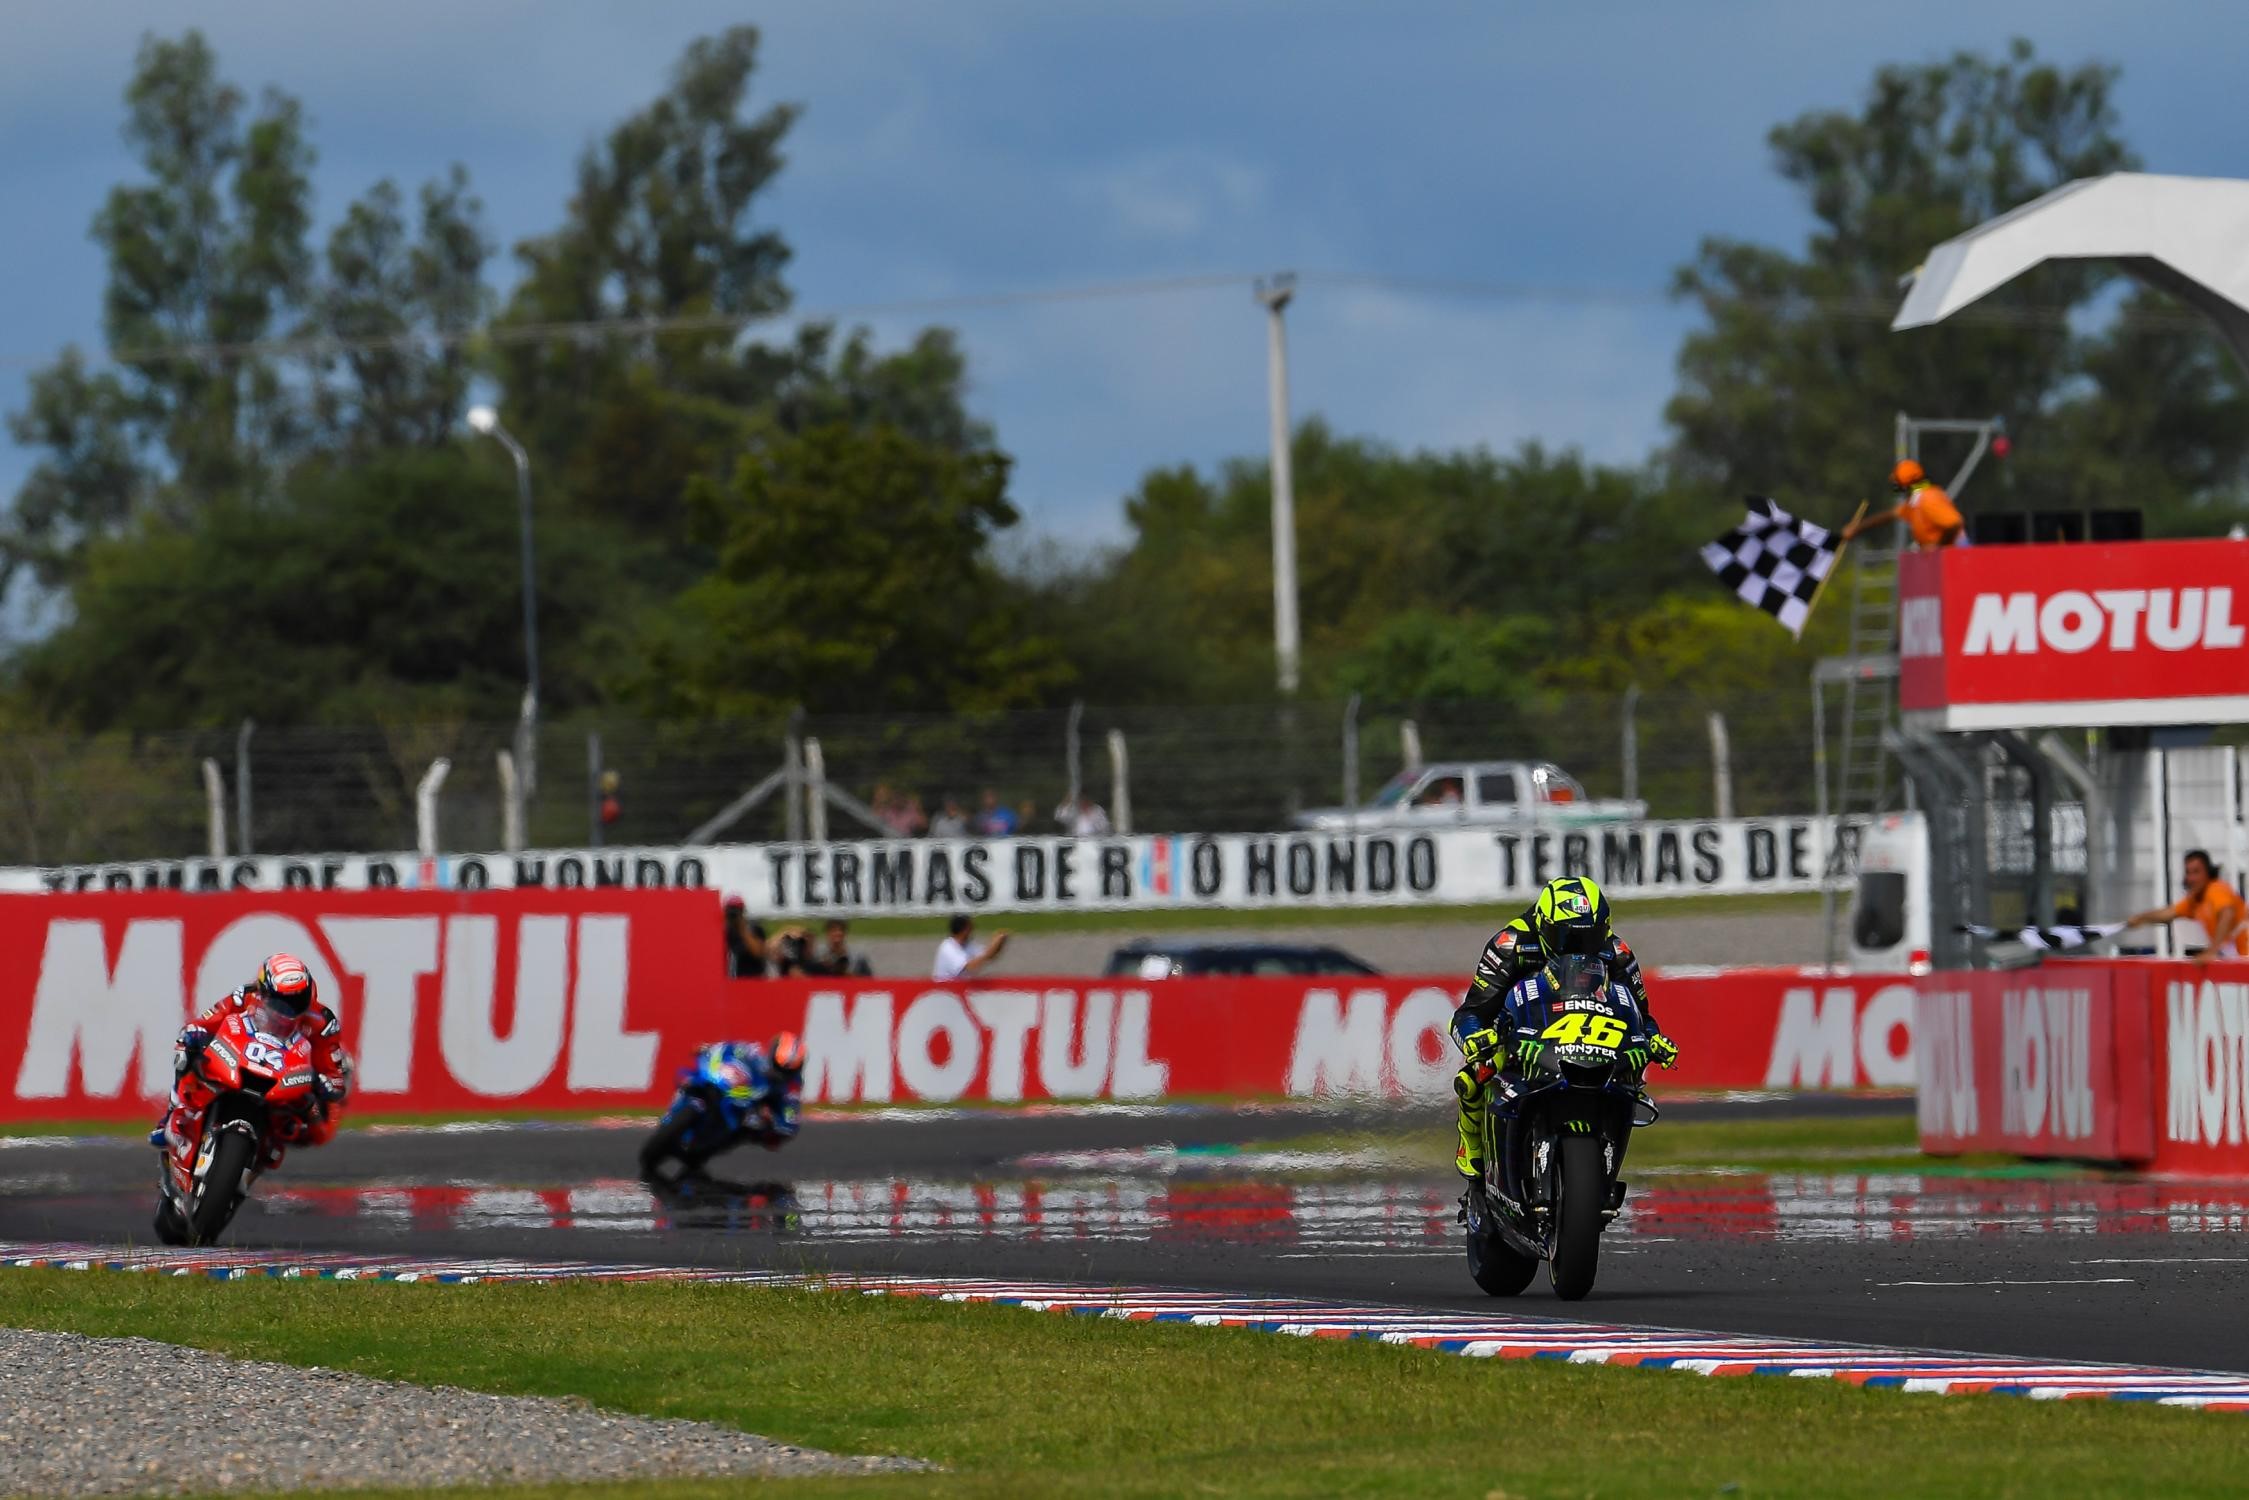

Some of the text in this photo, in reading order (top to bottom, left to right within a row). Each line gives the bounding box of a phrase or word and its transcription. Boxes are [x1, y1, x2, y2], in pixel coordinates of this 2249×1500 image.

[1961, 586, 2247, 655] MOTUL
[768, 845, 990, 906] TERMAS
[1015, 845, 1077, 900] DE
[1248, 837, 1437, 896] HONDO
[1497, 829, 1720, 886] TERMAS
[1747, 826, 1809, 880] DE
[1565, 1000, 1614, 1016] ENEOS
[802, 988, 1170, 1101] MOTUL
[1541, 1013, 1628, 1049] 46
[209, 1039, 237, 1067] Lenovo
[244, 1041, 284, 1072] 04
[1554, 1043, 1617, 1060] MONSTER
[1562, 1055, 1610, 1064] ENERGY
[2002, 985, 2095, 1140] MOTUL
[2167, 980, 2249, 1147] MOT
[281, 1074, 313, 1087] Lenovo
